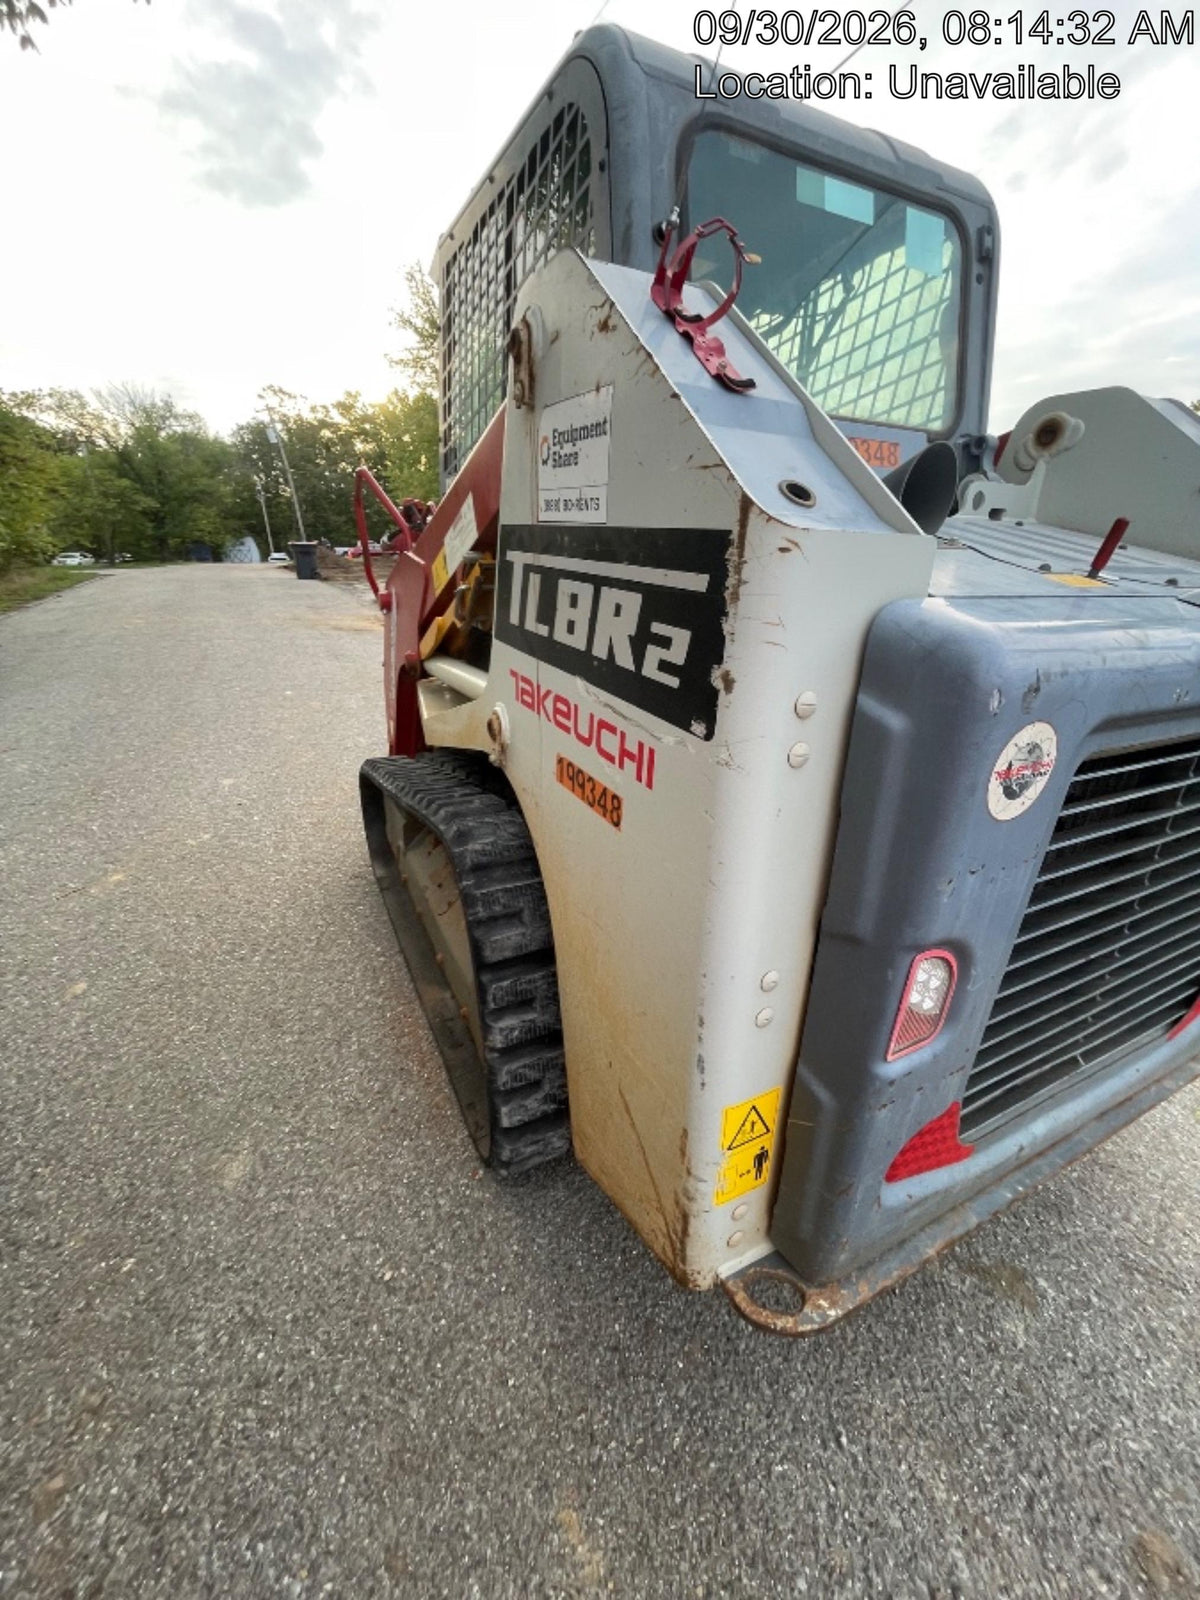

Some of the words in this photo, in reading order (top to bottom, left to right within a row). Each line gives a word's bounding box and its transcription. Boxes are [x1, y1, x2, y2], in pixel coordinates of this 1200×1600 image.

[552, 417, 608, 450] Equipment
[552, 451, 579, 468] Share
[556, 756, 622, 828] 199348
